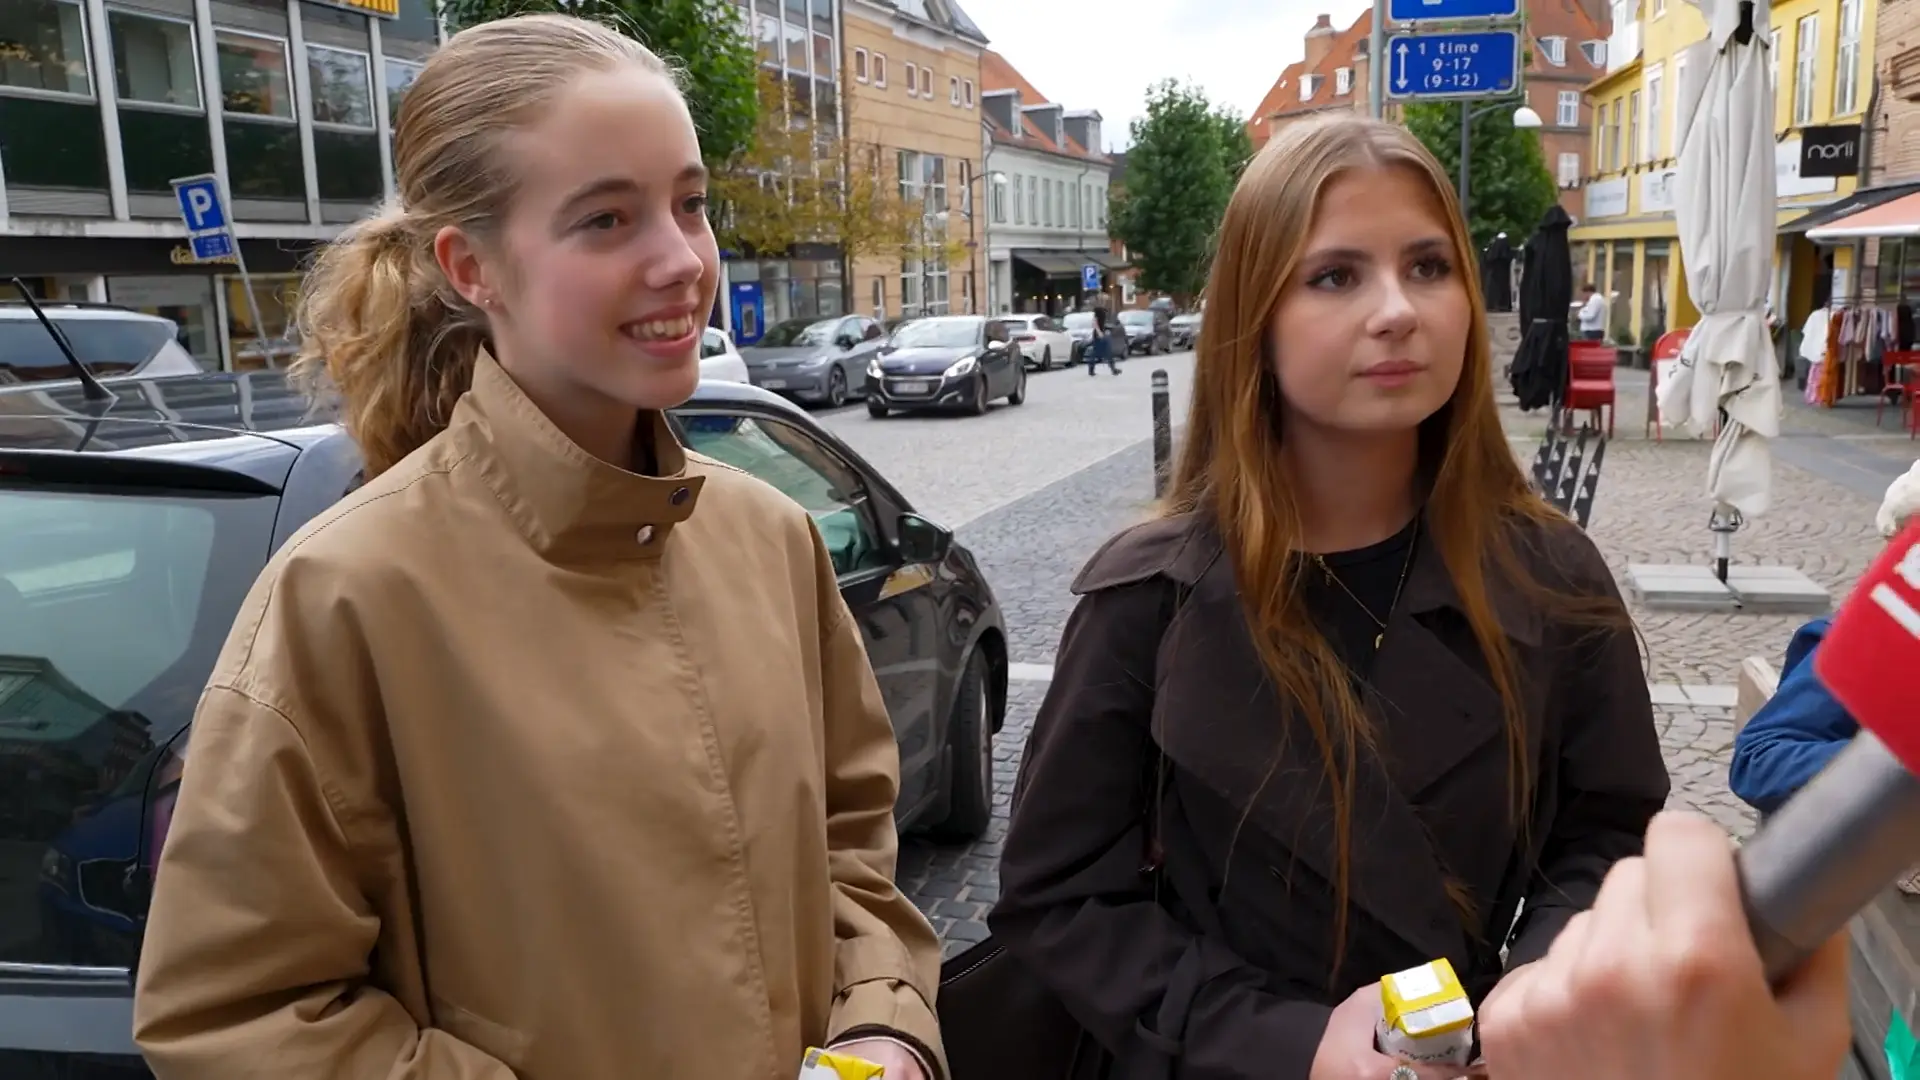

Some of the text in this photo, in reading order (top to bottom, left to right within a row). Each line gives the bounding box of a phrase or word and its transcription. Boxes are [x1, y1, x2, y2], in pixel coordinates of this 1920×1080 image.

[1418, 42, 1480, 55] 1 time
[1432, 57, 1472, 71] 9-17
[1423, 73, 1479, 89] (9-12)
[187, 188, 212, 227] P
[1086, 267, 1096, 280] P
